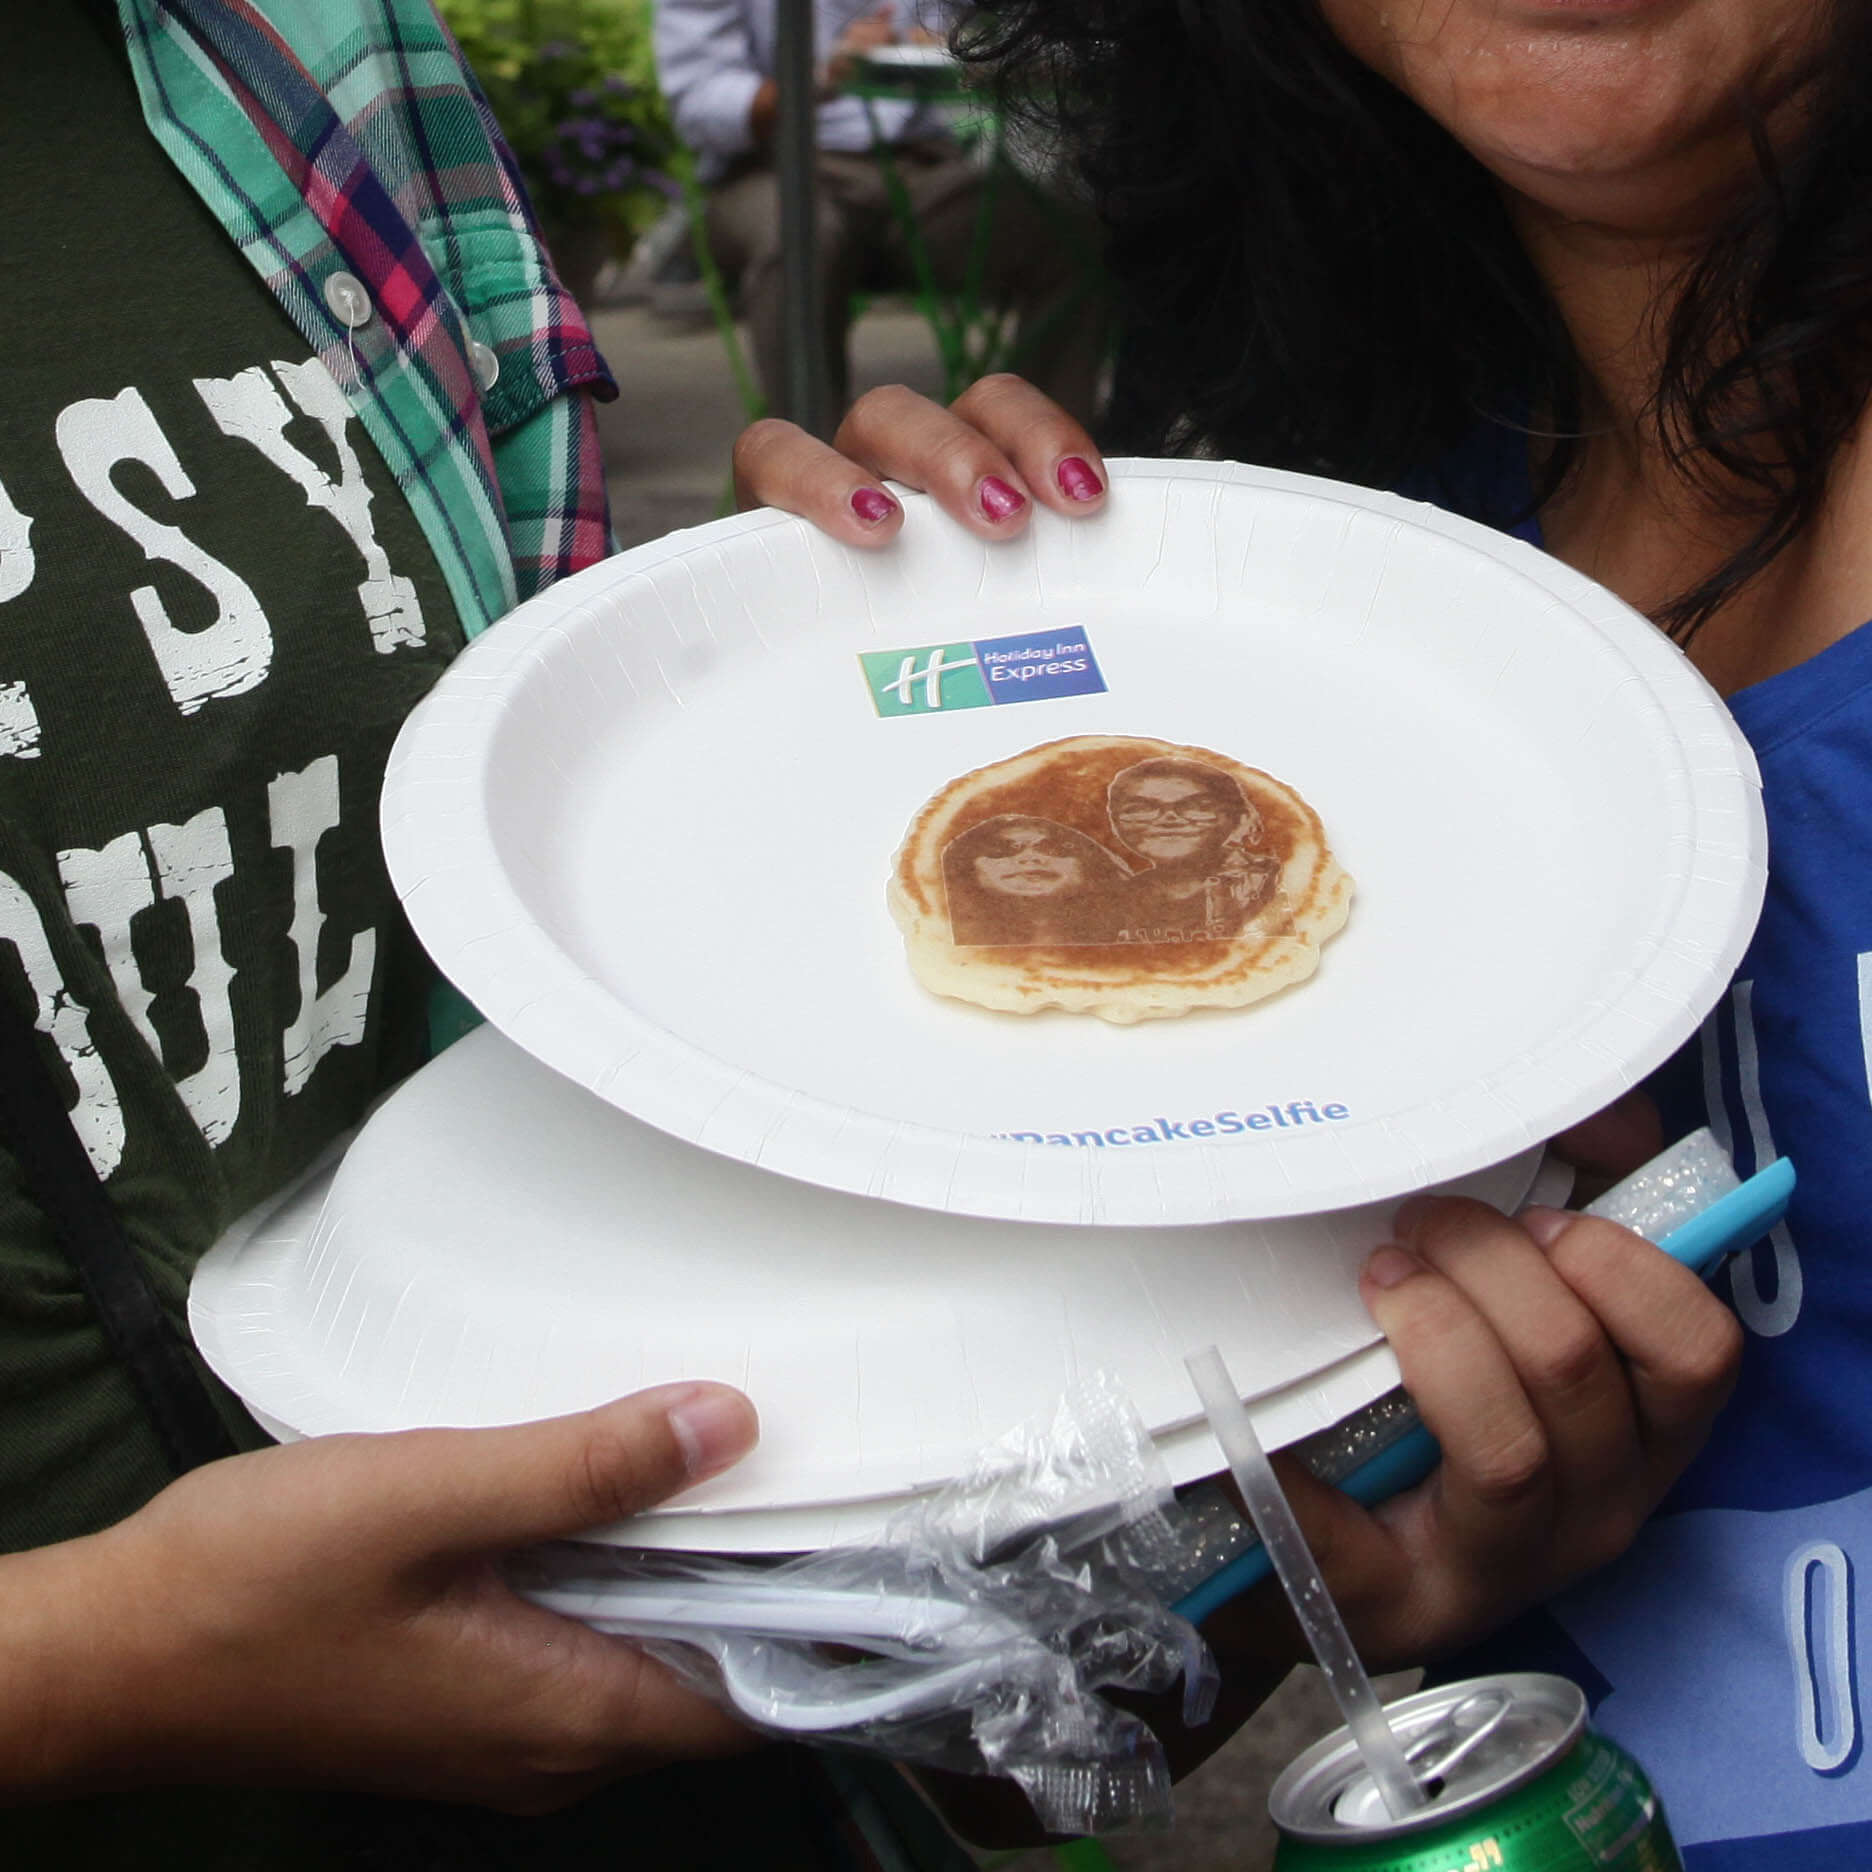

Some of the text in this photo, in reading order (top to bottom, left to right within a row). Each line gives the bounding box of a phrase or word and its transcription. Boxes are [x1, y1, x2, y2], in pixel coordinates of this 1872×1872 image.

[984, 643, 1087, 666] Holiday Inn
[991, 658, 1087, 682] Express
[990, 1100, 1351, 1147] PancakeSelfie
